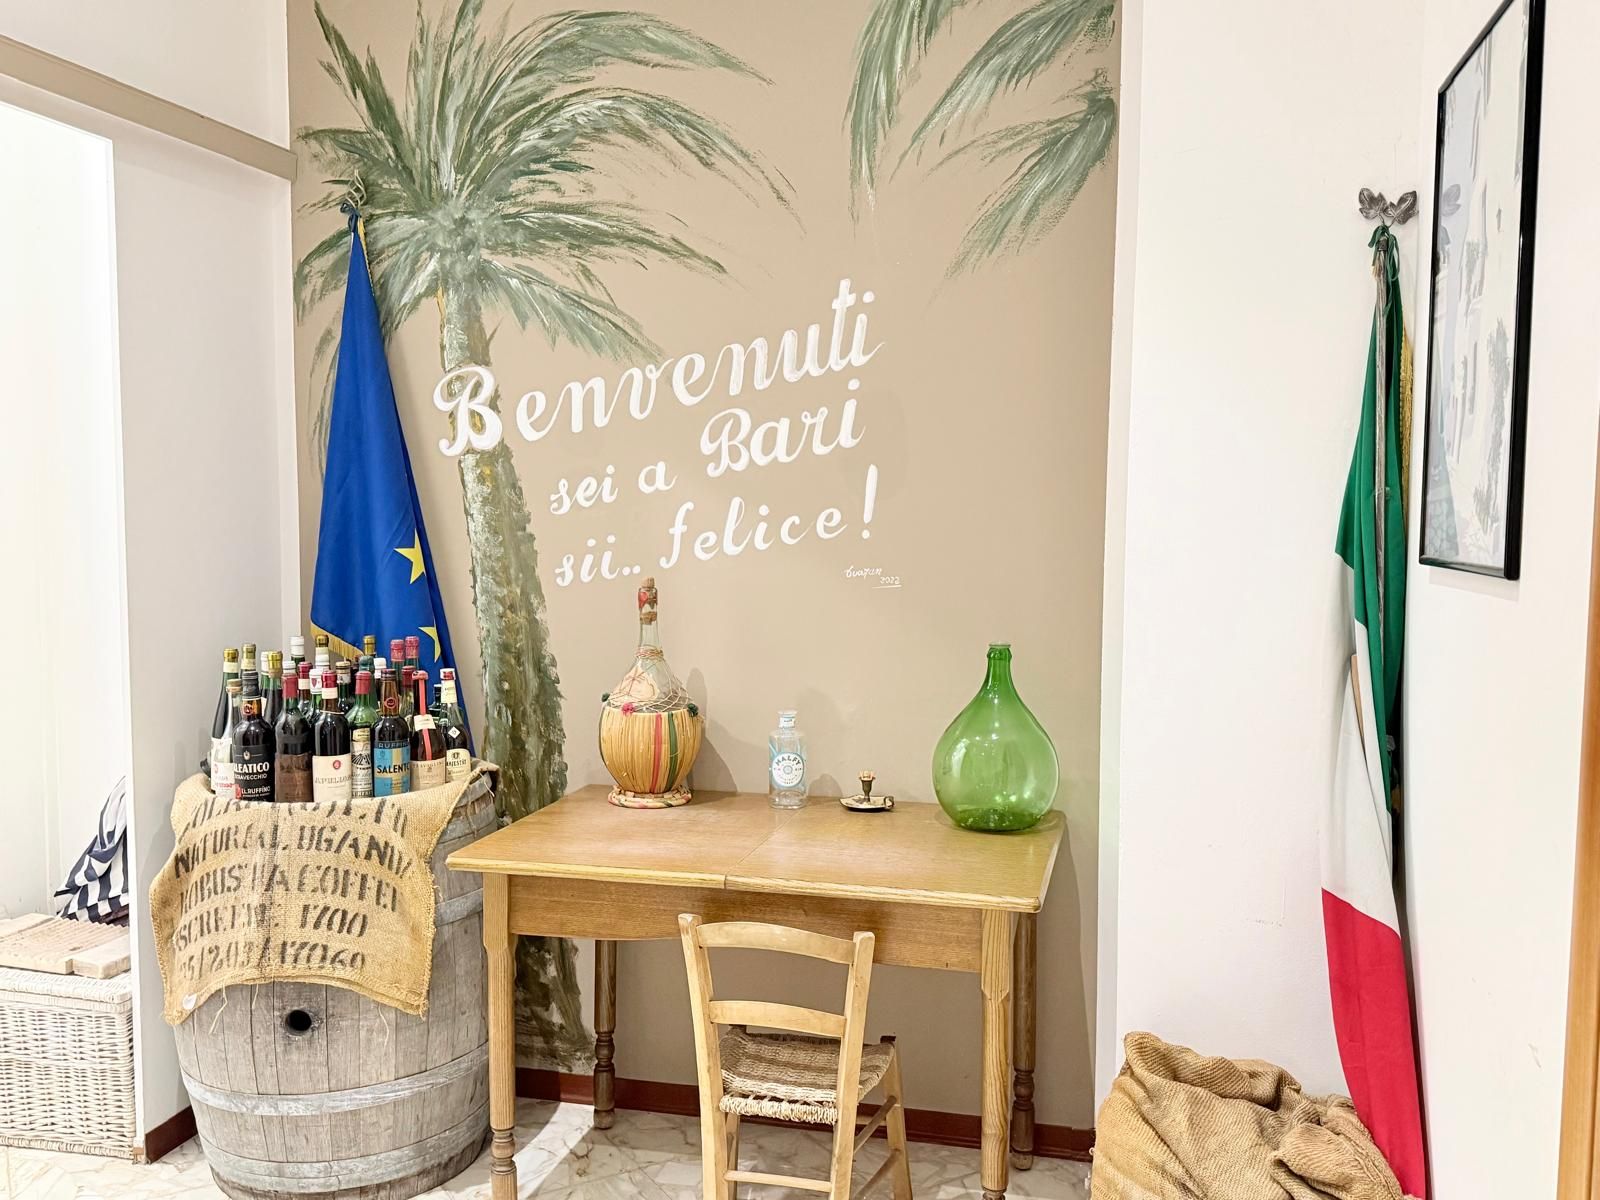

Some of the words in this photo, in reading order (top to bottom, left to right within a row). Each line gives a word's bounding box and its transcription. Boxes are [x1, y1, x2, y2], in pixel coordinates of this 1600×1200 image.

[433, 278, 885, 457] Benvenuti
[550, 465, 618, 515] sei
[638, 461, 677, 494] a
[700, 378, 866, 477] Bari
[233, 761, 270, 774] LEATICO
[775, 755, 801, 767] MALFY
